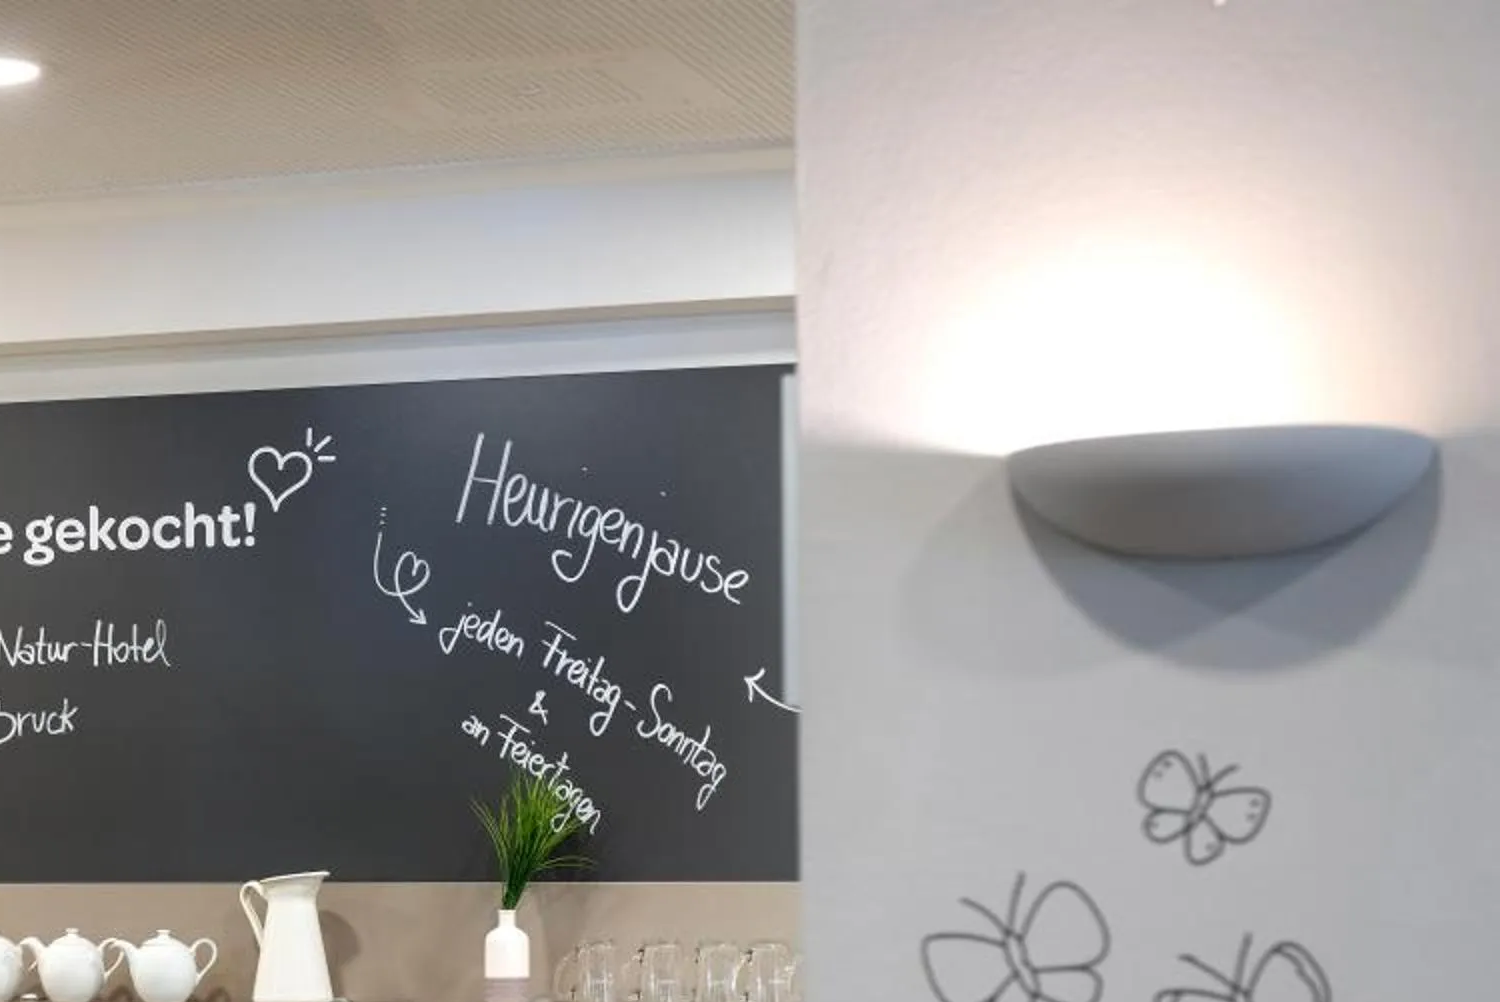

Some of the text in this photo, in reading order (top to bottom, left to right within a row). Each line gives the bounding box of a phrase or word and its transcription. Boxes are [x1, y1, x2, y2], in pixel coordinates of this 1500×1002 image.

[23, 501, 256, 567] gekocht!
[455, 432, 750, 613] Heurigenjause
[438, 602, 525, 656] jeden
[461, 715, 490, 746] an
[528, 690, 550, 726] &
